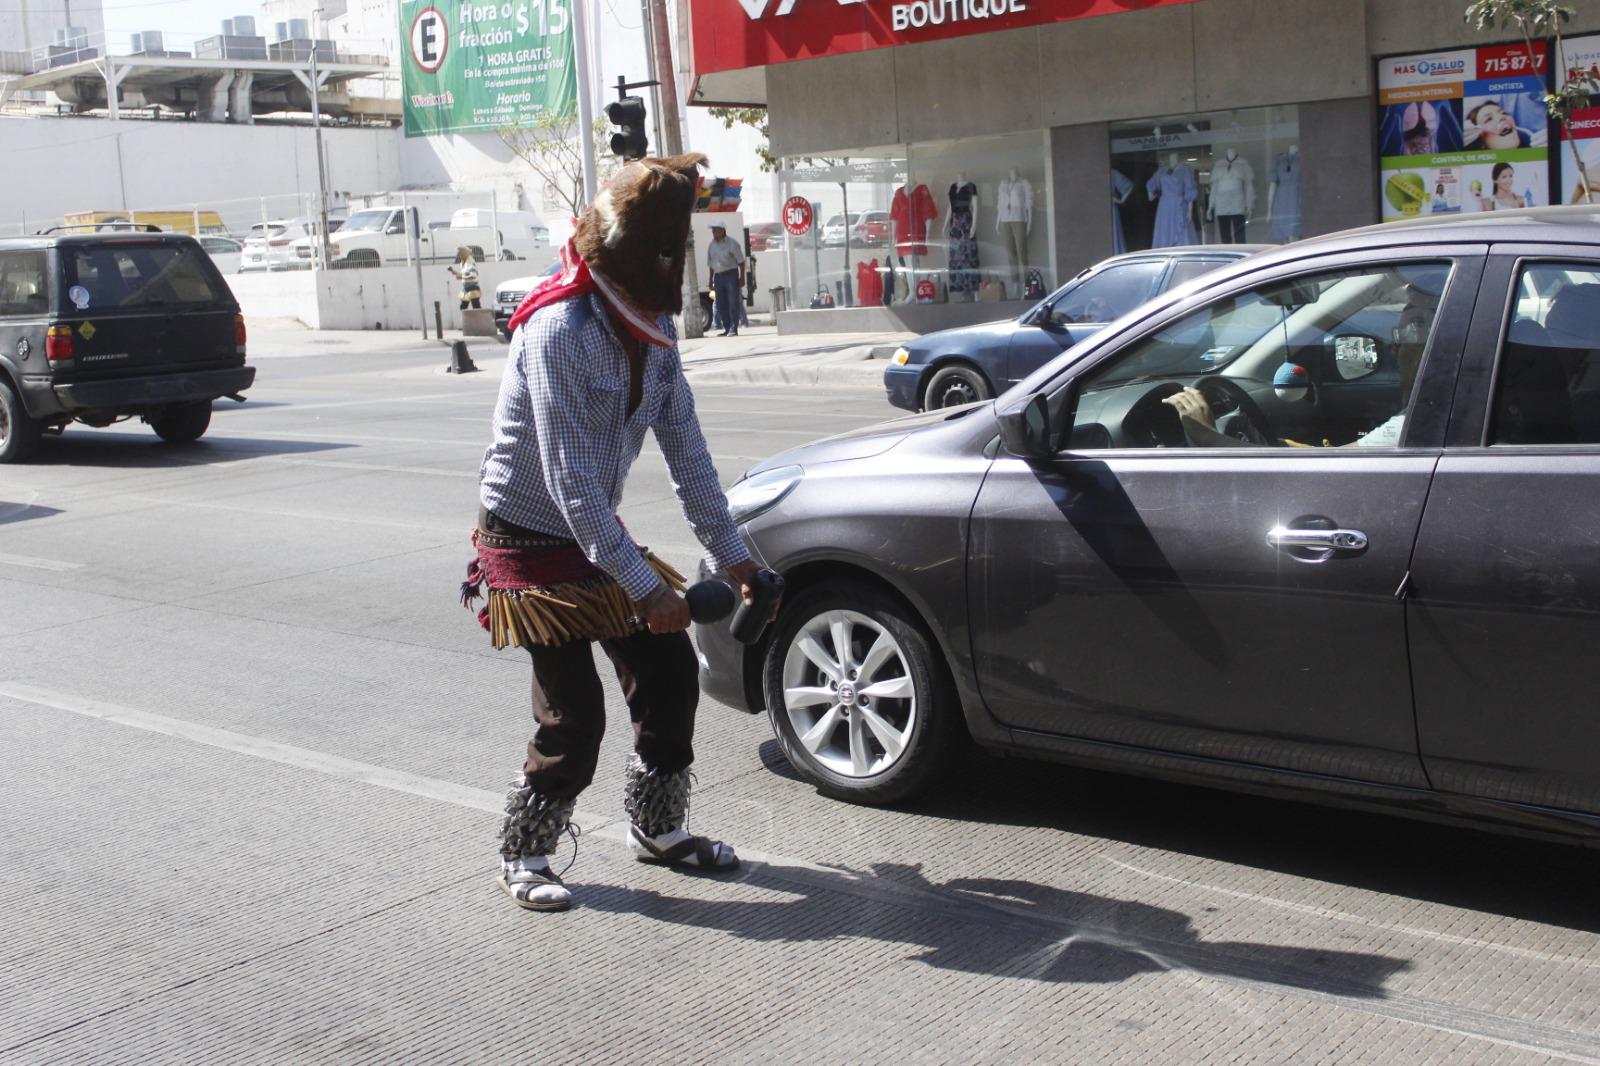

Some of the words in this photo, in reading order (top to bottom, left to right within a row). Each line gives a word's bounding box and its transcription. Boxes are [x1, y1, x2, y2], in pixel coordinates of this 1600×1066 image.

[459, 3, 497, 24] Hora
[501, 3, 512, 18] o
[892, 0, 1026, 31] BOUTIQUE
[420, 17, 438, 62] E
[459, 26, 513, 48] fracción
[488, 52, 514, 66] HORA
[516, 46, 552, 62] GRATIS
[483, 68, 509, 78] compra
[1394, 64, 1416, 74] MAS
[1430, 60, 1465, 71] SALUD
[1488, 82, 1524, 92] DENTISTA
[496, 91, 531, 104] Horario
[1432, 155, 1465, 164] CONTROL
[1478, 153, 1497, 161] PESO
